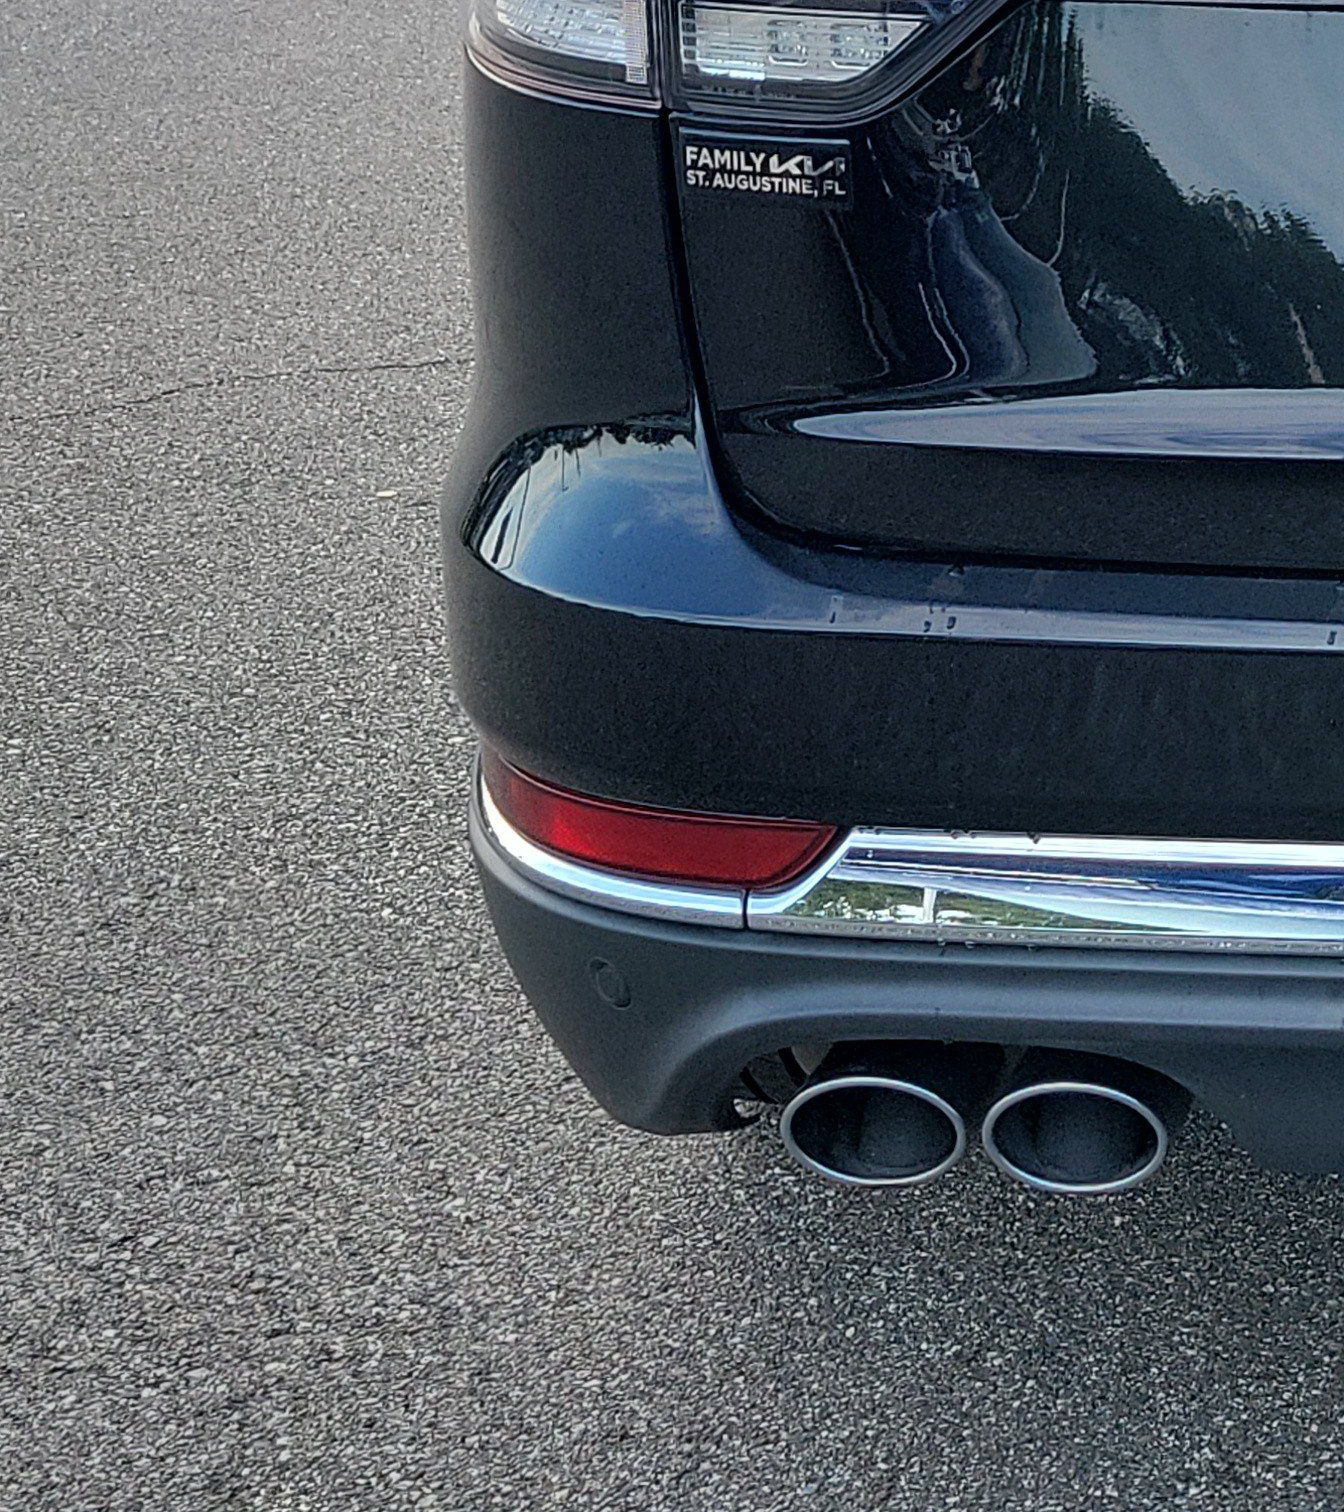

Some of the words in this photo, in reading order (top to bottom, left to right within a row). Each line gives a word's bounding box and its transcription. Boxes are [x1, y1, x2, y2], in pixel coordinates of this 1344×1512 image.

[685, 145, 766, 173] FAMILY
[686, 169, 711, 188] ST.
[712, 174, 819, 198] AUGUSTINE,
[822, 179, 847, 196] FL
